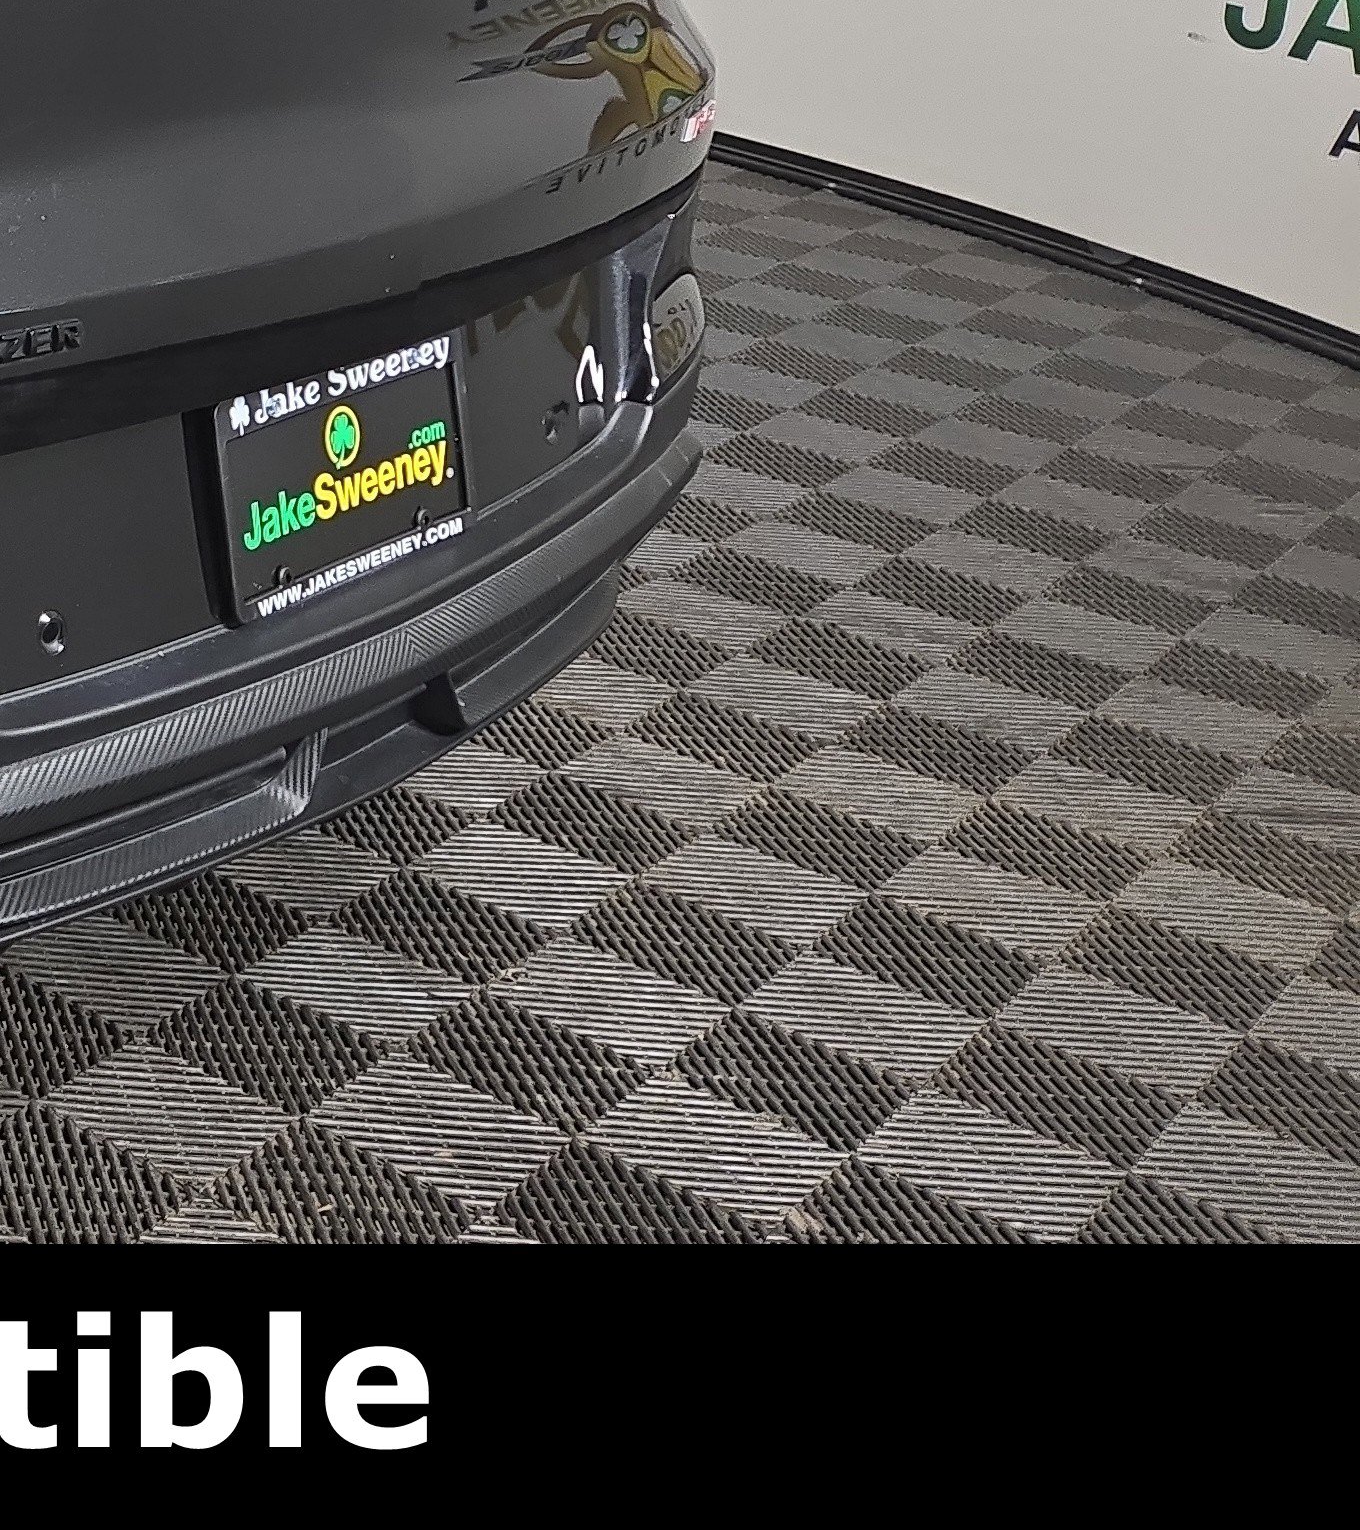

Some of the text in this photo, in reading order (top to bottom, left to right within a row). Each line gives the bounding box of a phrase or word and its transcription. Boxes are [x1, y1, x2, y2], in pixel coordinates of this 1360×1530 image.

[254, 335, 450, 425] Jake Sweeney
[407, 420, 446, 449] .com
[257, 517, 464, 617] WWW.JAKESWEENEY.COM
